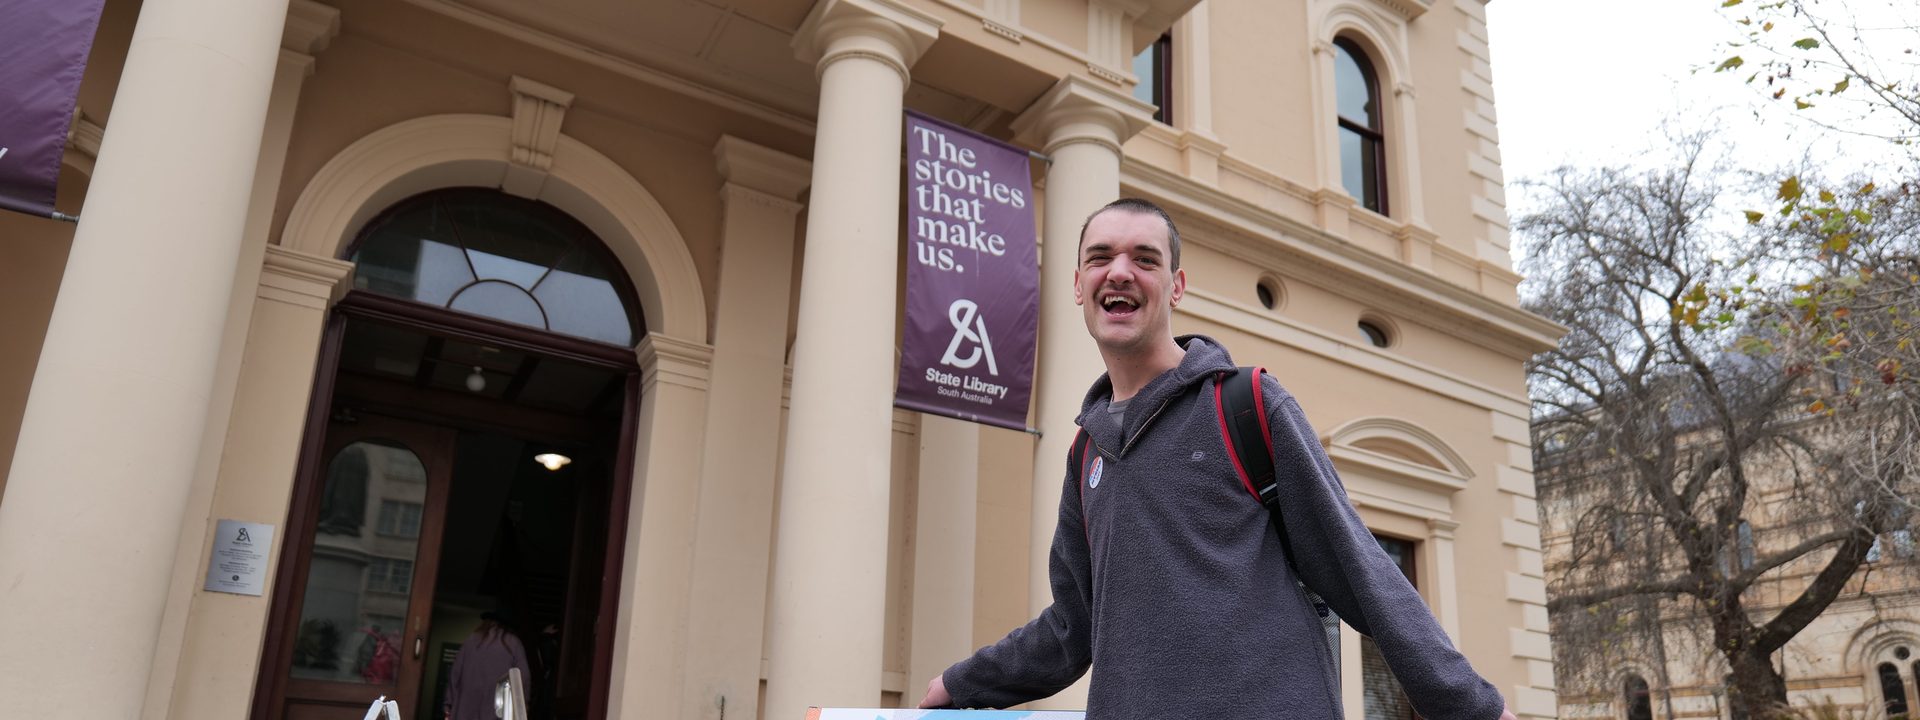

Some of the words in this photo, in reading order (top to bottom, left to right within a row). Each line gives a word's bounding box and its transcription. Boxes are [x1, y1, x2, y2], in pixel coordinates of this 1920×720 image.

[914, 125, 976, 168] The
[915, 159, 1025, 209] stories
[916, 184, 986, 224] that
[917, 216, 1006, 256] make
[916, 241, 964, 273] us.
[925, 367, 961, 387] State
[963, 375, 1008, 399] Library
[937, 386, 960, 398] South
[960, 391, 993, 405] Australia
